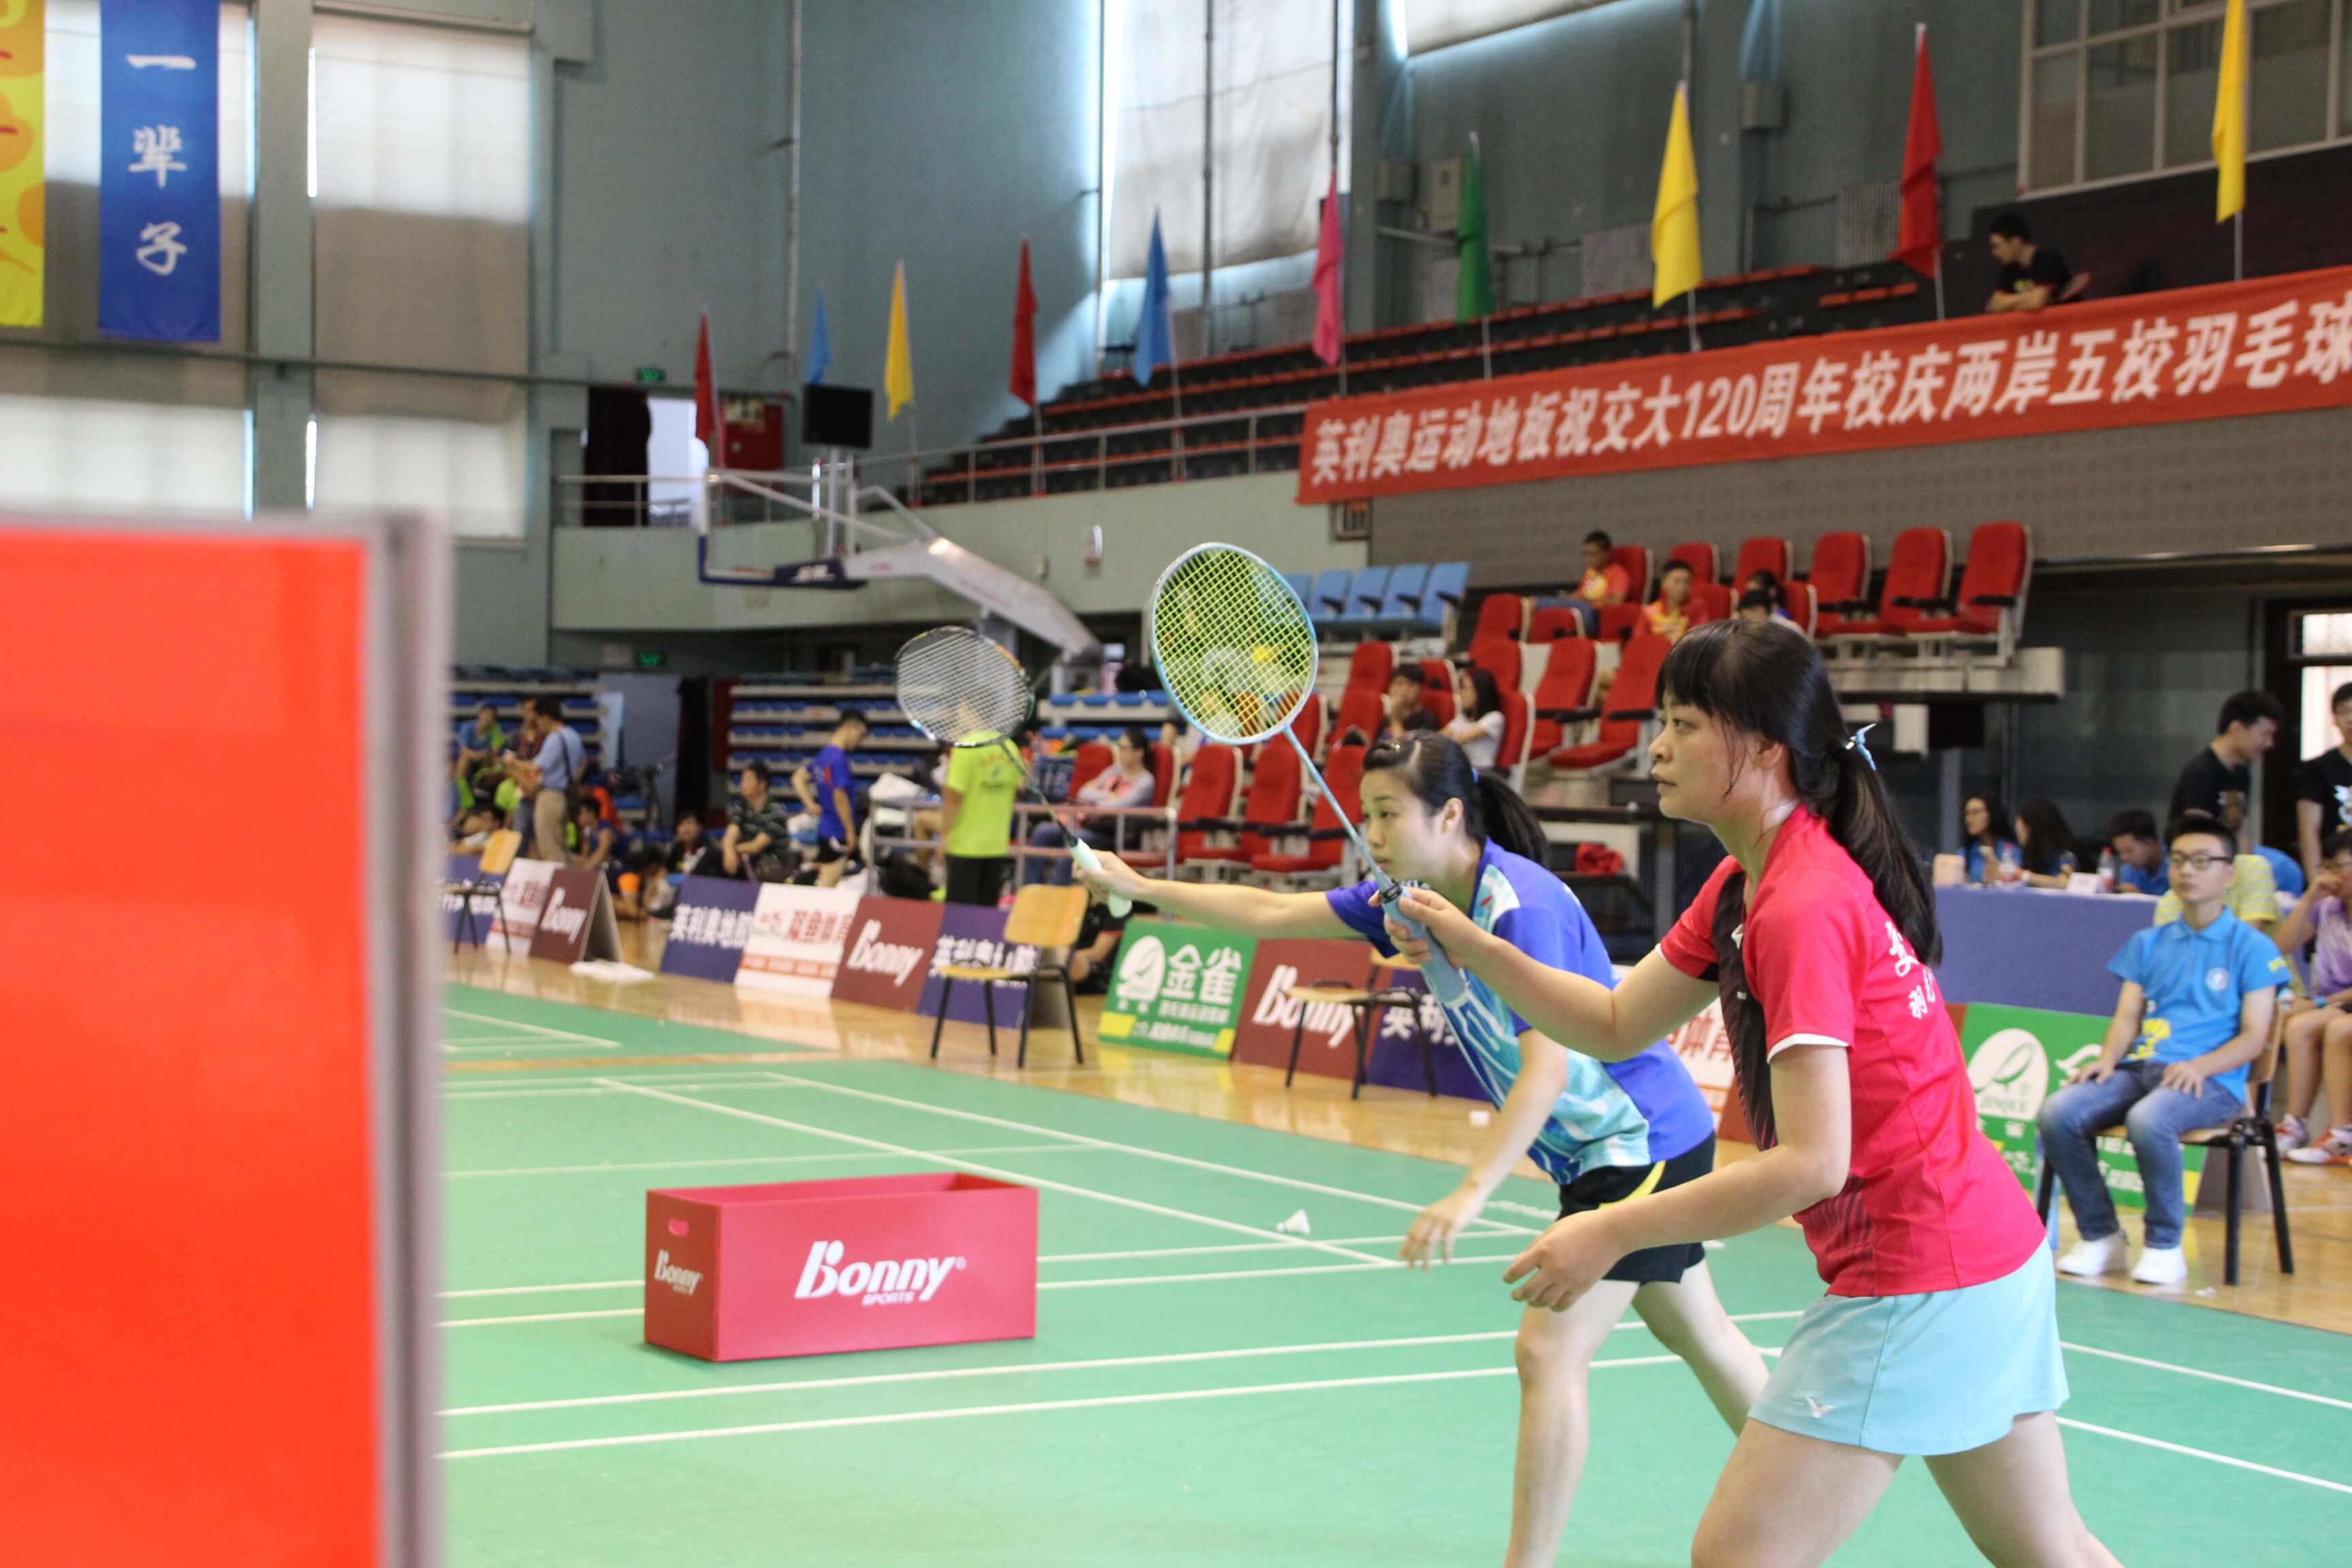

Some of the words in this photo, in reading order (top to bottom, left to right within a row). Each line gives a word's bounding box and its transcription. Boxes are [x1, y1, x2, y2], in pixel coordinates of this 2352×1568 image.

[127, 54, 197, 275] 一辈子
[541, 887, 588, 945] Bonny
[847, 919, 924, 987] Bonny
[1160, 943, 1242, 1004] 金雀
[654, 1249, 704, 1296] Bonny
[794, 1239, 956, 1302] Bonny
[862, 1291, 916, 1307] SPORTS
